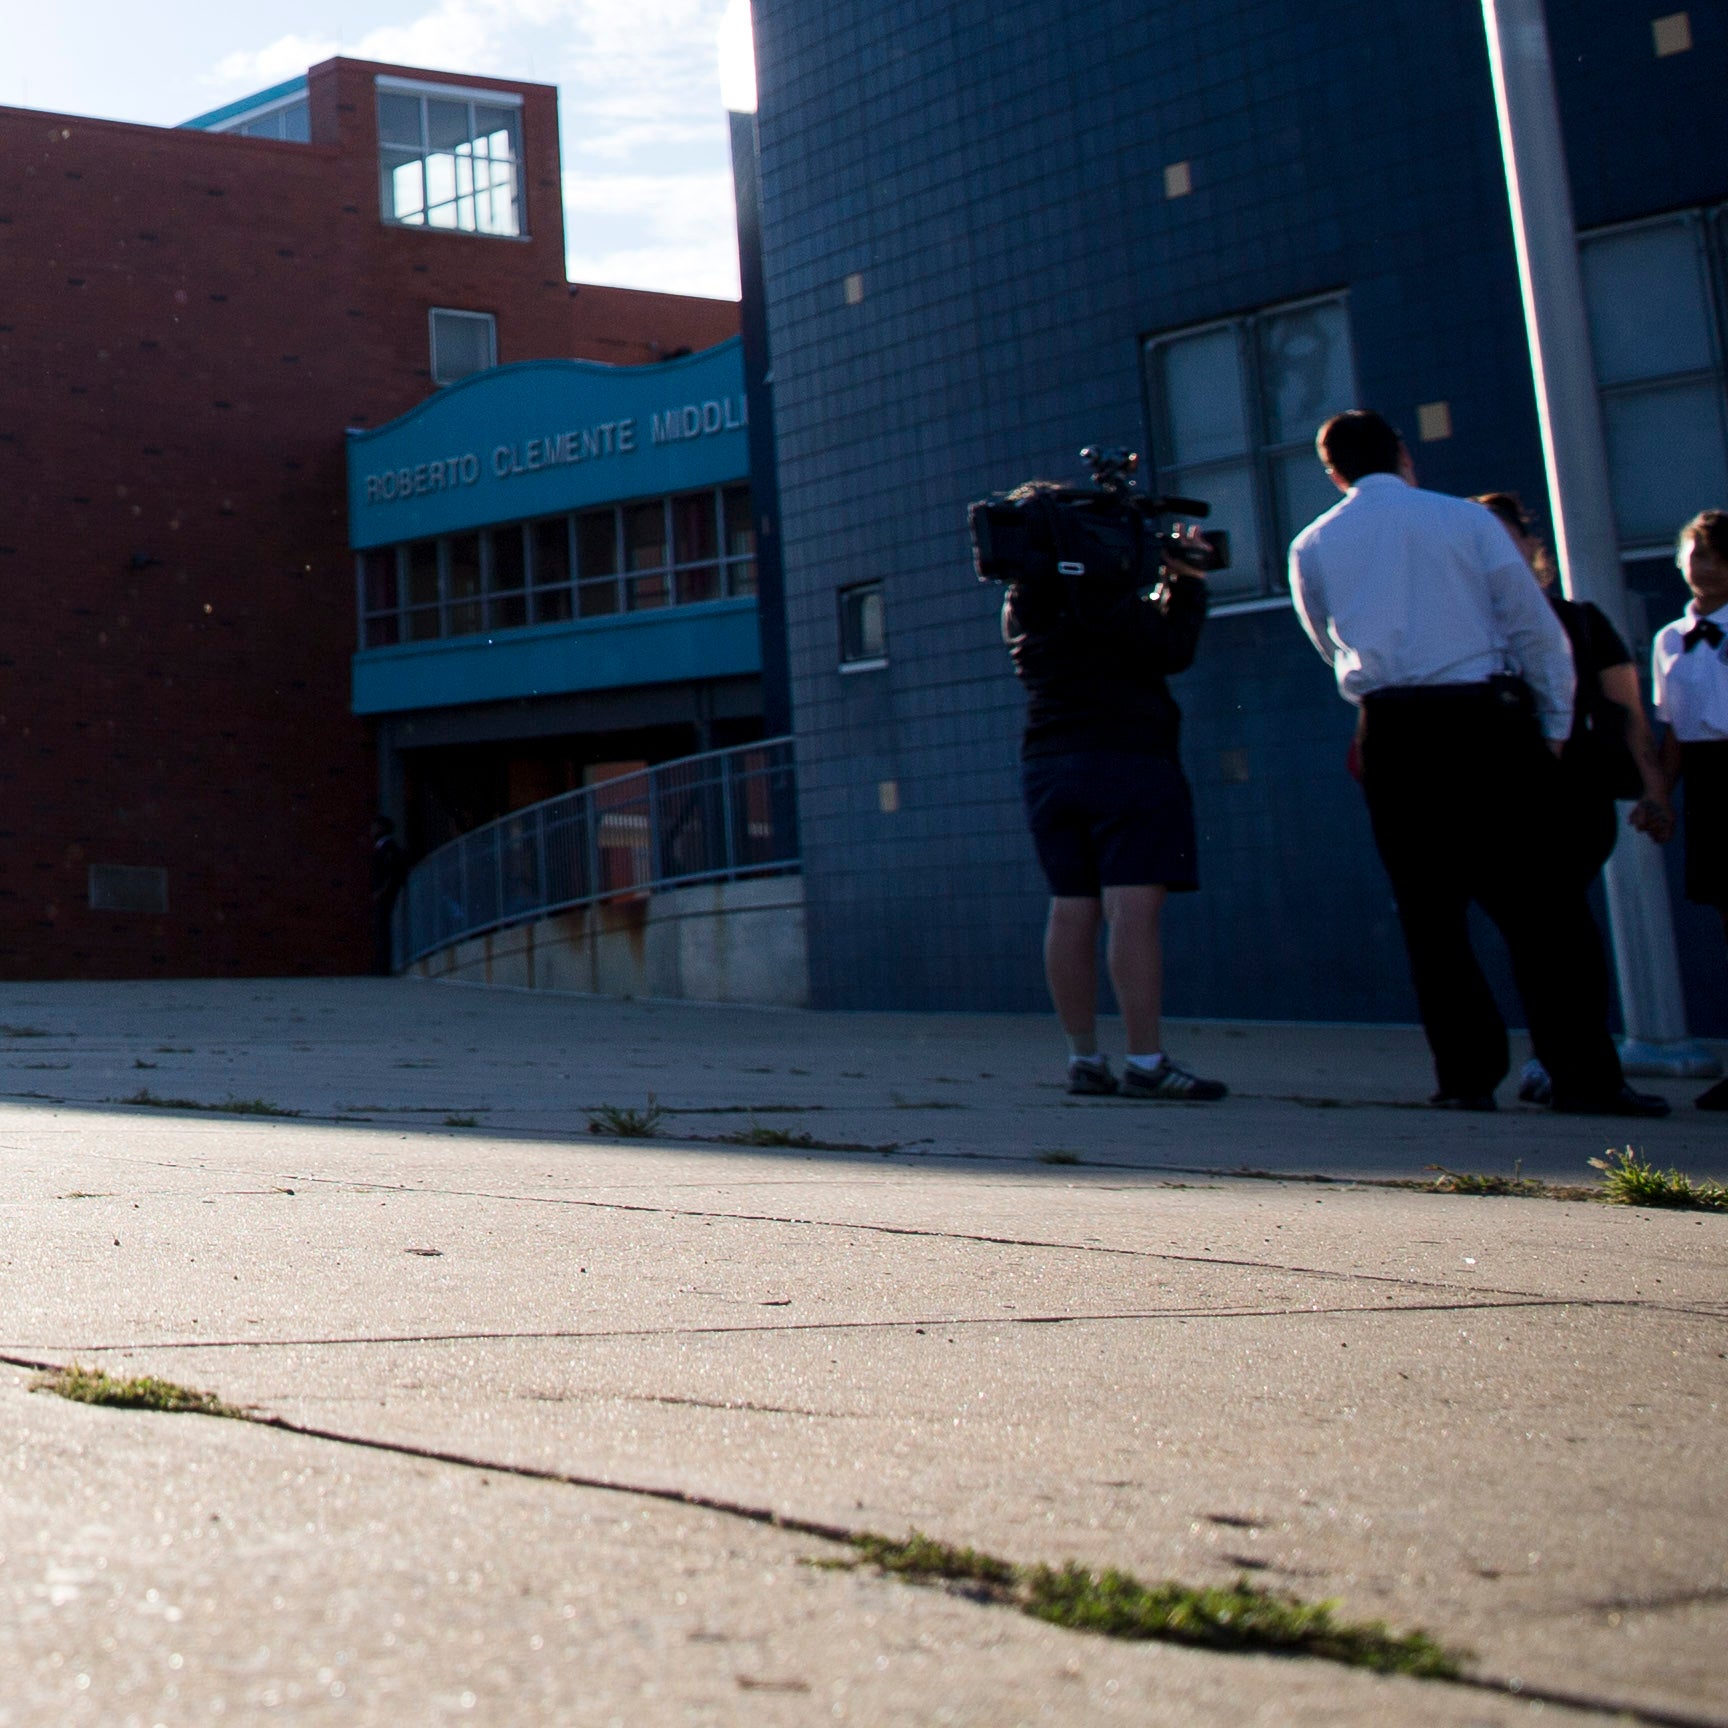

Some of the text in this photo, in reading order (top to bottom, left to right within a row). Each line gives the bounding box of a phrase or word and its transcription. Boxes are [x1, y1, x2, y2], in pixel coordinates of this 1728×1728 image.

[366, 394, 749, 505] ROBERTO CLEMENTE MIDDL
